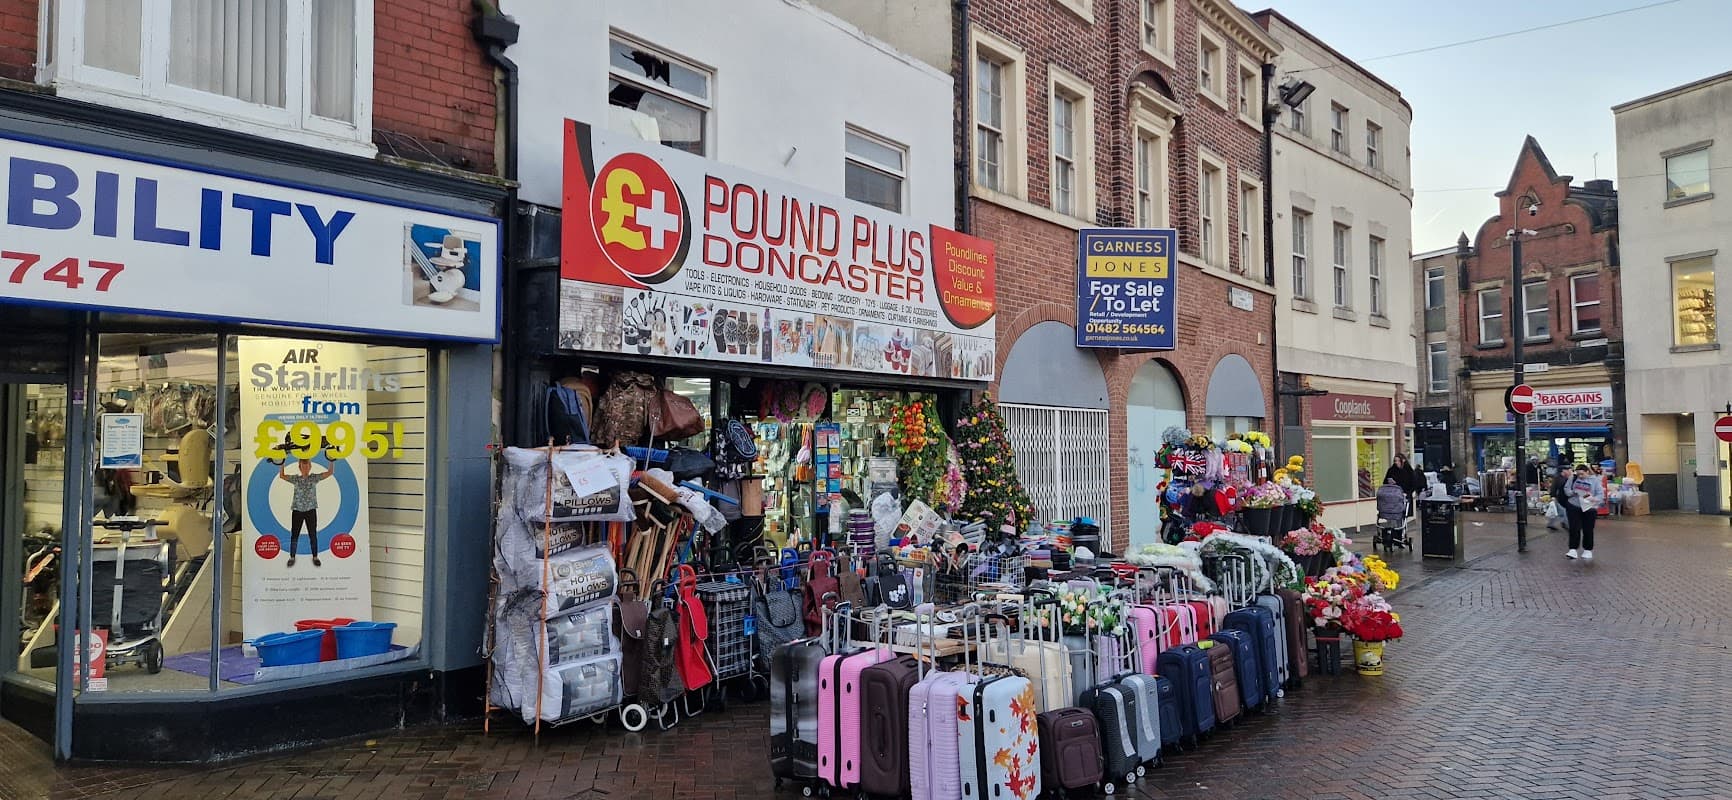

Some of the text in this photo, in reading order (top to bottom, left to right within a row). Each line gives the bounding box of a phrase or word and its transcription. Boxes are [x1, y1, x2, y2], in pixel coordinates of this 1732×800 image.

[7, 156, 356, 265] BILITY
[704, 173, 925, 277] POUND PLUS
[945, 241, 988, 264] Poundlines
[1093, 240, 1162, 253] GARNESS
[1, 250, 124, 292] 747
[702, 232, 924, 303] DONCASTER
[1093, 261, 1161, 273] JONES
[687, 268, 705, 281] TOOLS
[710, 275, 749, 288] ELECTRONICS
[754, 279, 787, 294] HOUSEHOLD
[789, 286, 807, 297] GOODS
[811, 289, 833, 301] BEDDING
[838, 293, 861, 305] CROCKERY
[865, 298, 876, 308] TOYS
[879, 300, 899, 312] LUGGAGE
[913, 306, 938, 319] ACCESSORIES
[951, 275, 983, 294] Value &
[1090, 280, 1165, 297] For Sale
[685, 280, 701, 294] VAPE
[702, 285, 716, 296] KITS
[718, 287, 722, 297] &
[723, 288, 746, 300] LIQUIDS
[750, 291, 783, 305] HARDWARE
[786, 296, 817, 311] STATIONERY
[821, 303, 829, 312] PET
[831, 305, 856, 317] PRODUCTS
[858, 309, 885, 321] ORNAMENTS
[888, 313, 908, 324] CURTAINS
[912, 317, 938, 329] FURNISHINGS
[1103, 296, 1126, 312] To
[1130, 296, 1161, 313] Let
[1086, 323, 1165, 335] 01482 564564
[282, 349, 319, 364] AIR
[251, 363, 401, 393] Stairlifts
[302, 396, 361, 416] from
[1334, 398, 1371, 416] Cooplands
[1542, 393, 1603, 406] BARGAINS
[254, 418, 405, 461] £995!
[564, 496, 612, 508] PILLOWS
[571, 572, 602, 586] HOTEL
[566, 580, 610, 598] PILLOWS
